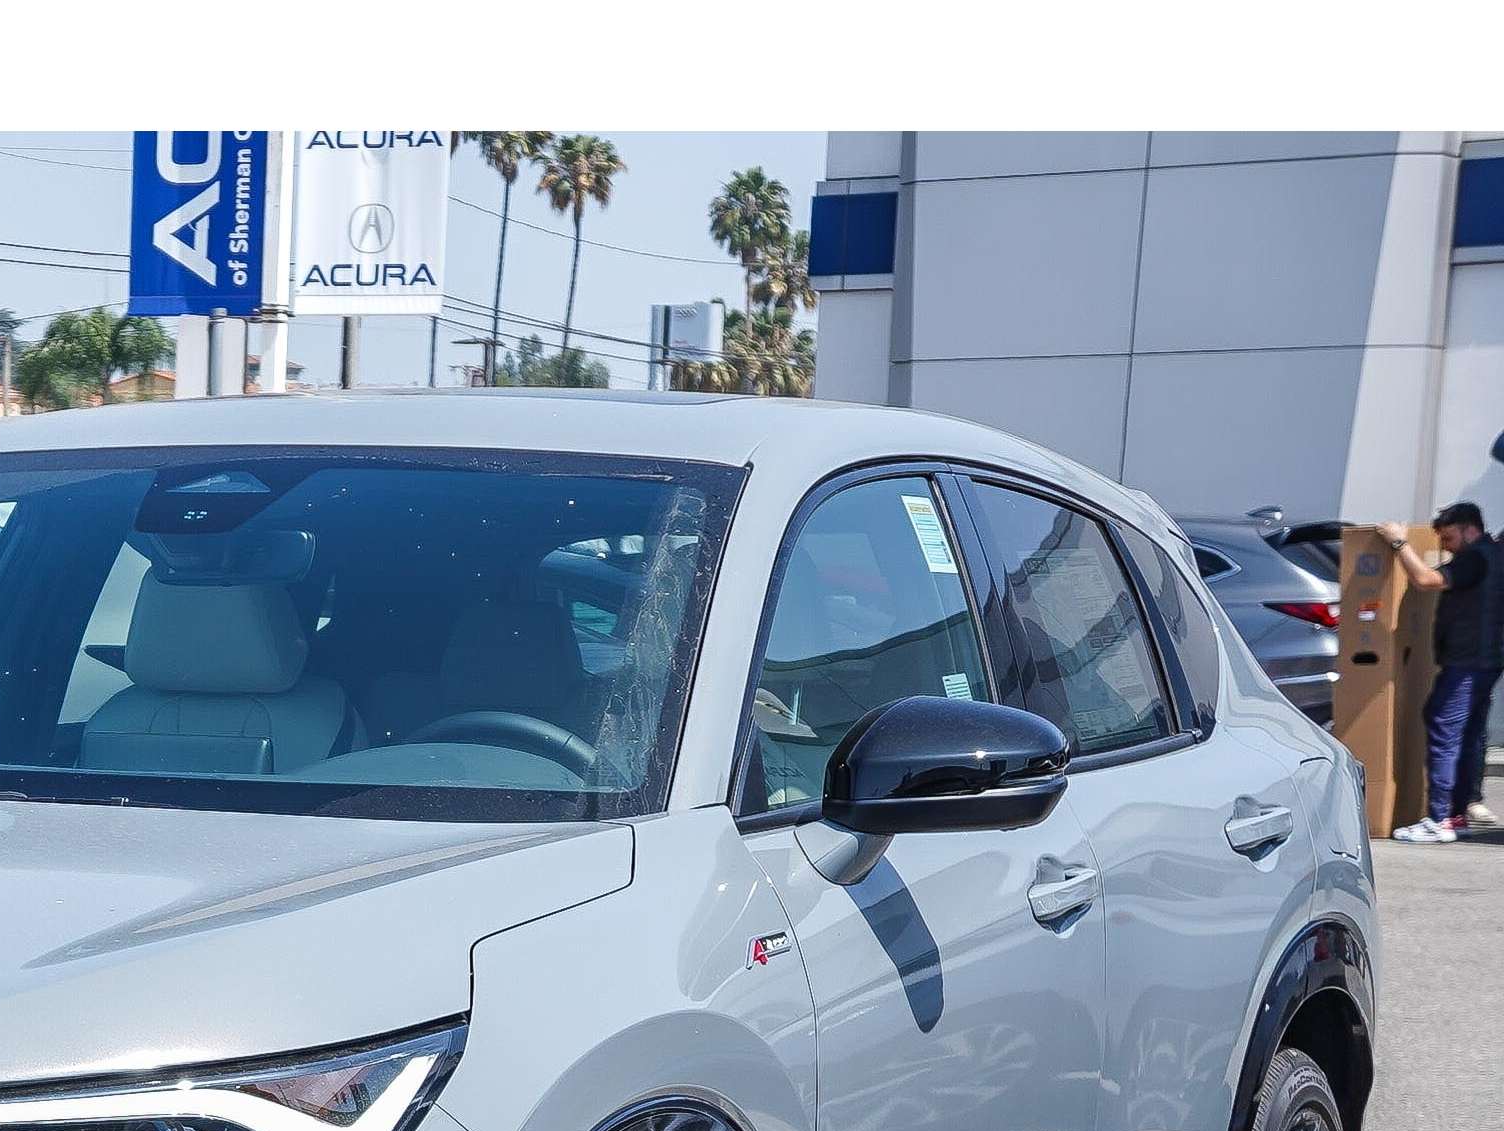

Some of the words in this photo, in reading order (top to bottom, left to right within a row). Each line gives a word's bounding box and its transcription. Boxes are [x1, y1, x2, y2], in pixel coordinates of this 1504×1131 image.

[305, 131, 444, 149] ACURA
[229, 148, 252, 254] Sherman
[228, 259, 248, 285] of
[301, 263, 437, 287] ACURA
